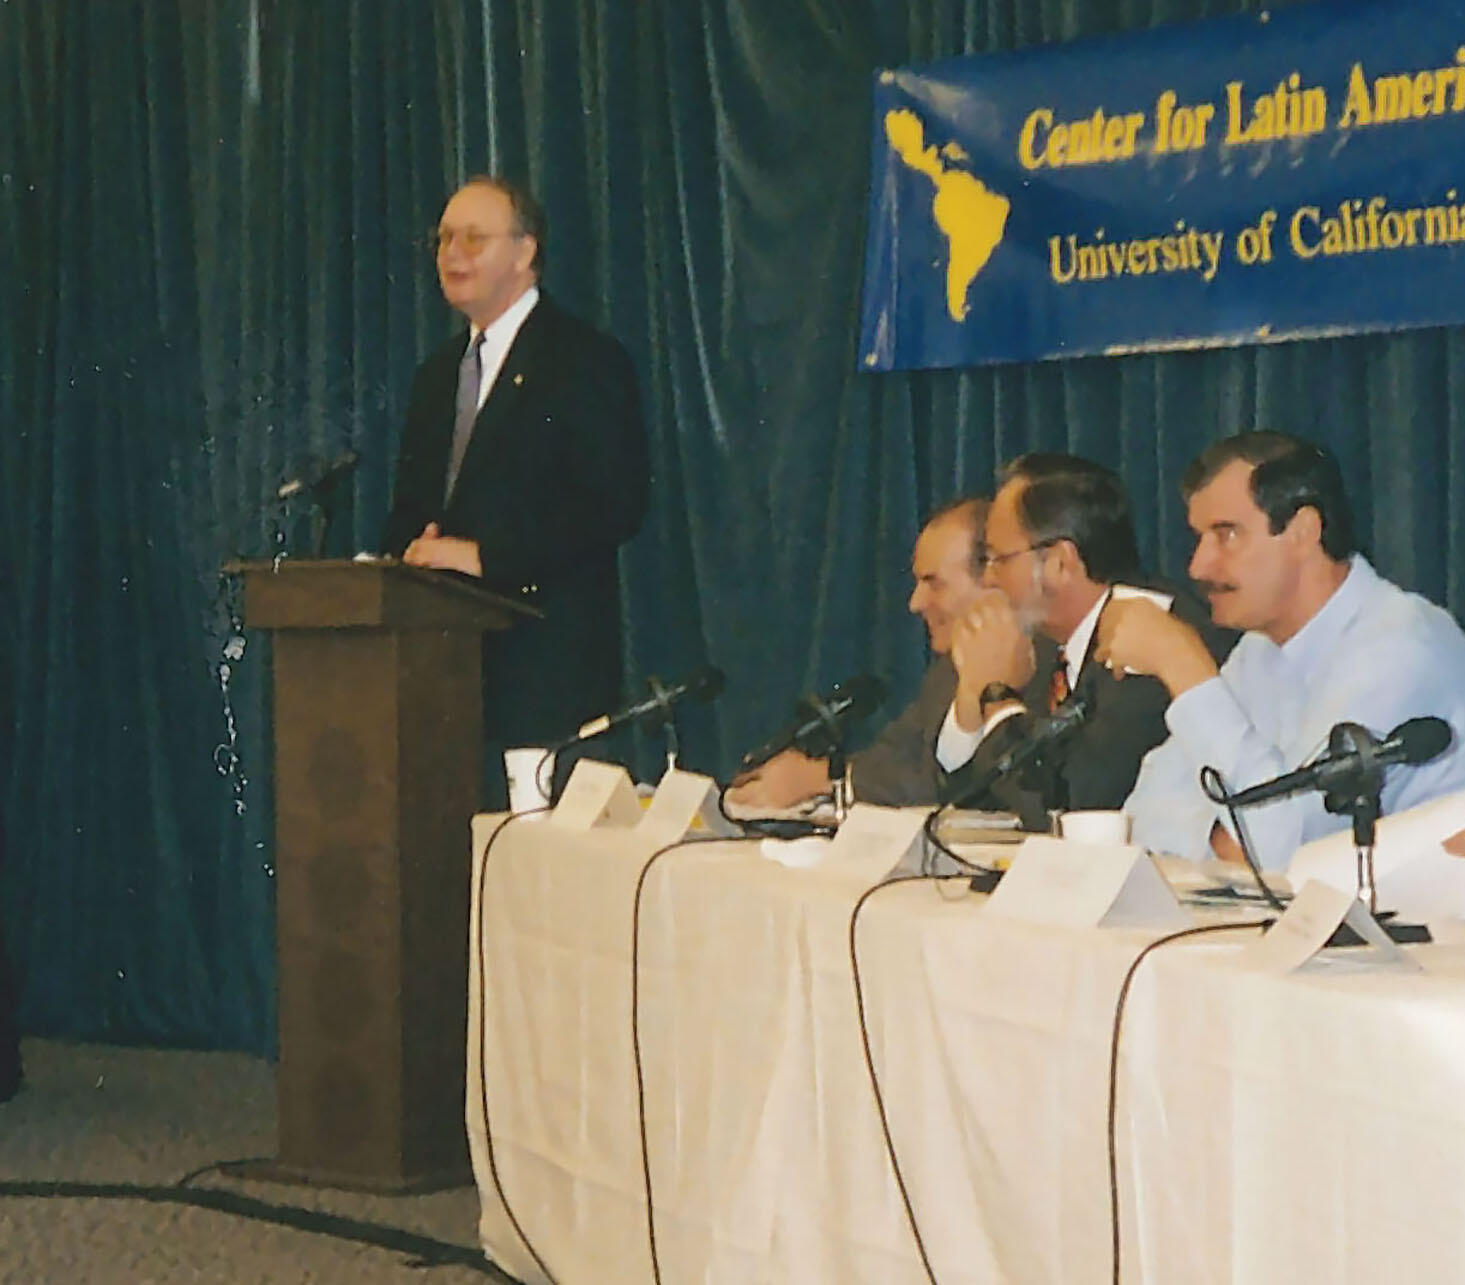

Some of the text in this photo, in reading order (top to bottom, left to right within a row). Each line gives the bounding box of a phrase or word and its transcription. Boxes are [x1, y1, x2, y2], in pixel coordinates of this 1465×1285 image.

[1018, 108, 1145, 171] Center
[1151, 89, 1215, 155] for
[1224, 72, 1327, 146] Latin
[1049, 219, 1224, 284] University
[1236, 210, 1277, 265] of
